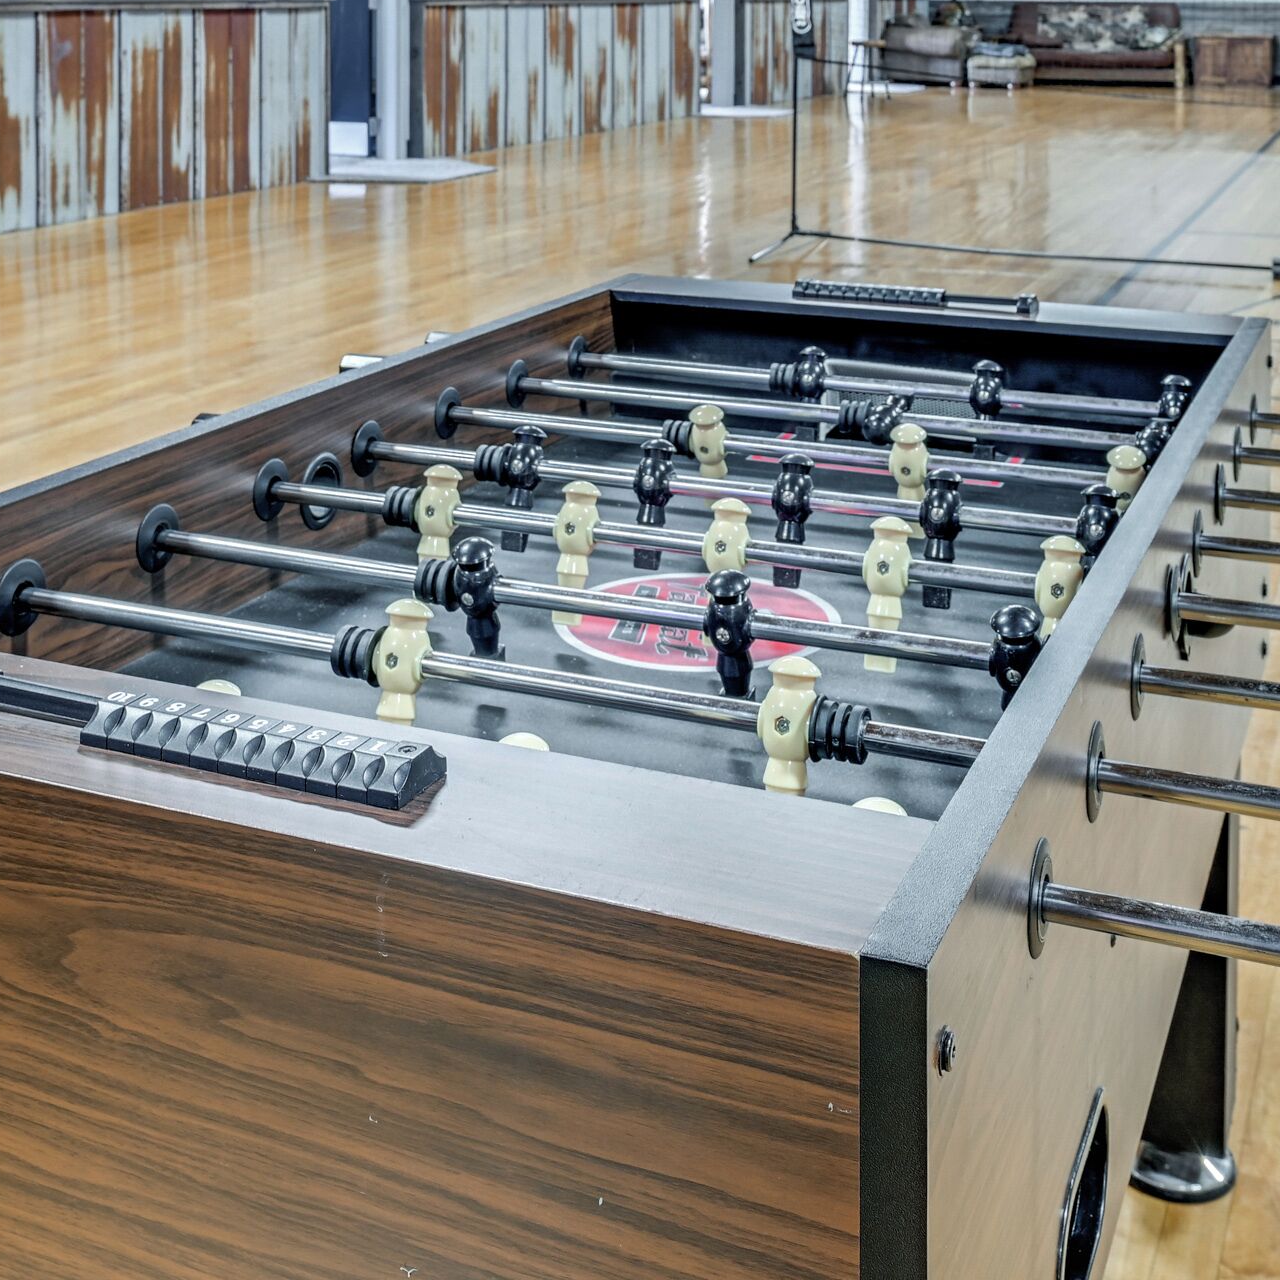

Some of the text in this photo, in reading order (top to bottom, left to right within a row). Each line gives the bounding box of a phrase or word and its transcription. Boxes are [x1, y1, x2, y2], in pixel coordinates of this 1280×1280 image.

[107, 691, 390, 752] 1 2 3 4 5 6 7 8 9 10
